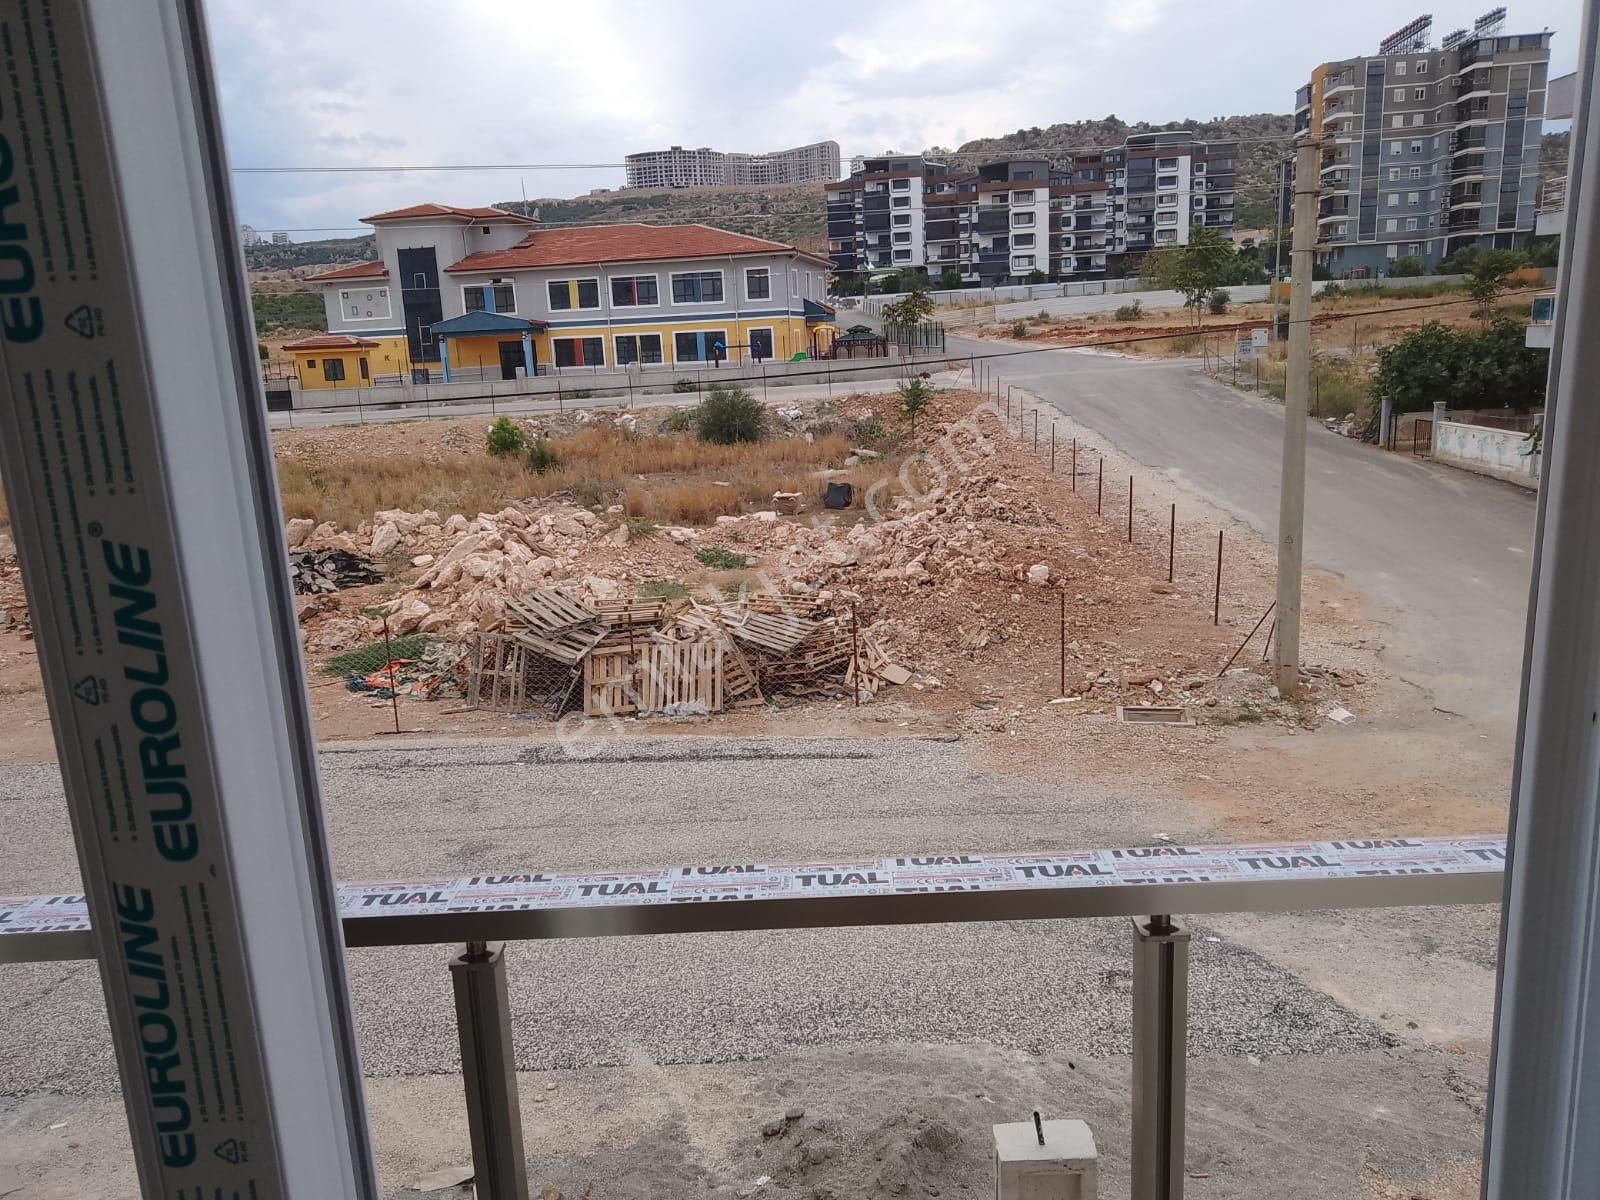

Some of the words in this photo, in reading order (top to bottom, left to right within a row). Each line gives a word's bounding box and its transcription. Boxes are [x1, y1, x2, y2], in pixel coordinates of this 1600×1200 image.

[102, 539, 199, 862] EUROLINE
[1015, 863, 1113, 878] TUAL
[1239, 856, 1341, 870] TUAL
[794, 872, 889, 887] TUAL
[578, 882, 667, 896] TUAL
[361, 891, 449, 906] TUAL
[112, 881, 198, 1169] EUROLINE
